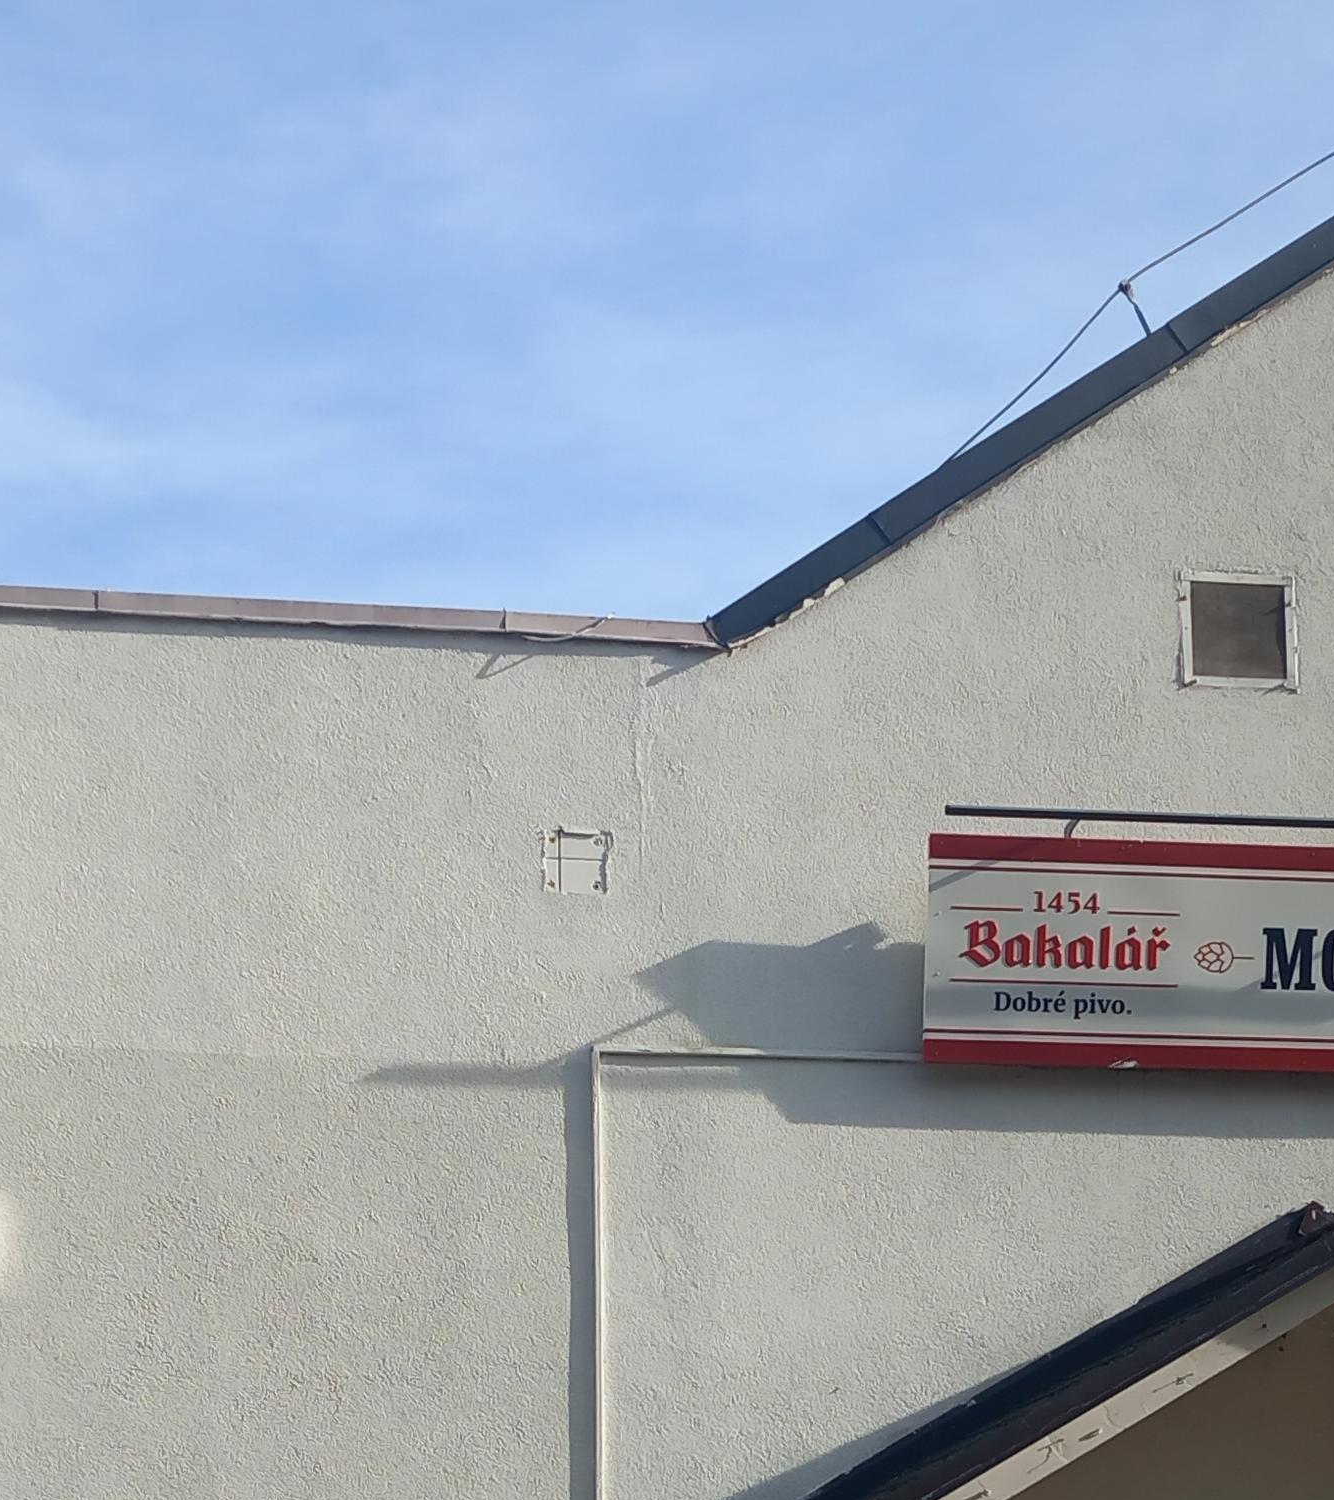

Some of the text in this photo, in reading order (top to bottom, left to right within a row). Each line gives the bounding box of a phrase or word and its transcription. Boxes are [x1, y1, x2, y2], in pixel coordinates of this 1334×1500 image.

[1033, 890, 1101, 915] 1454
[958, 918, 1171, 972] Bakalář
[993, 990, 1133, 1020] Dobré pivo.
